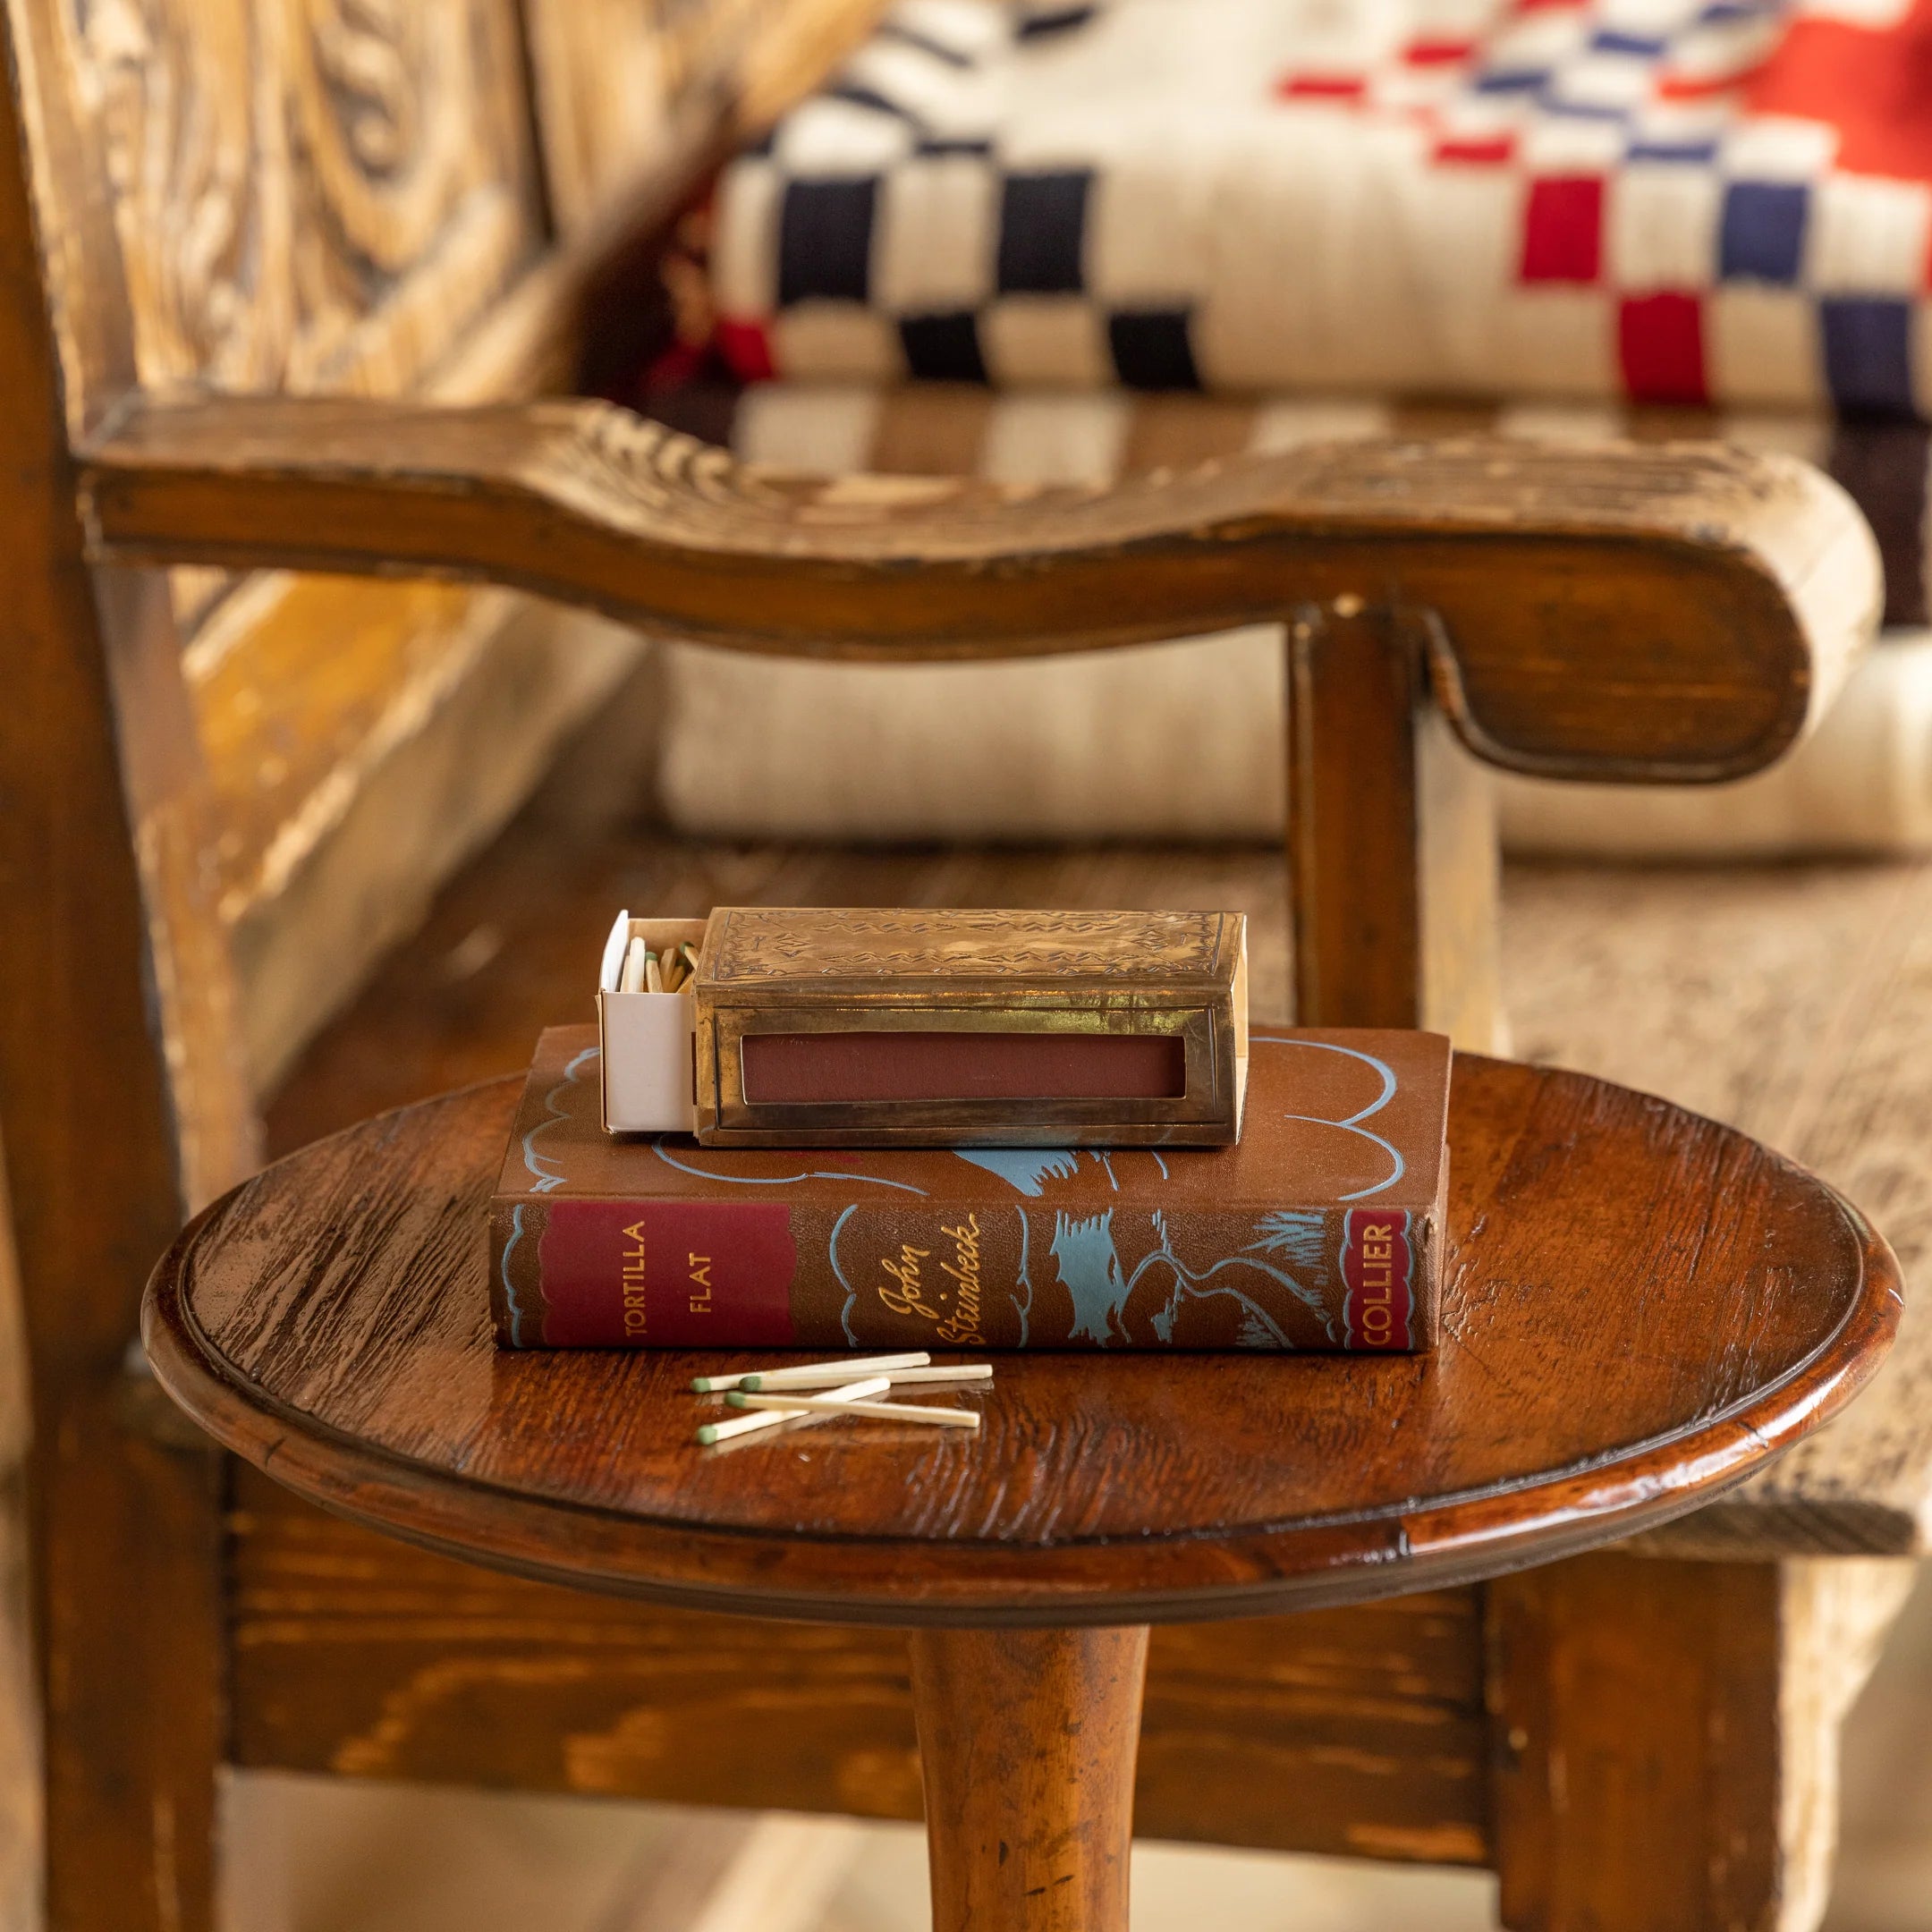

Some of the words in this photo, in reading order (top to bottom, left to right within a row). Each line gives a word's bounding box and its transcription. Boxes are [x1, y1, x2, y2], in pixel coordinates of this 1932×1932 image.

[622, 1221, 646, 1336] TORTILLA
[690, 1252, 712, 1313] FLAT
[877, 1244, 940, 1319] John
[936, 1213, 987, 1345] Steinbeck
[1362, 1223, 1393, 1345] COLLIER
